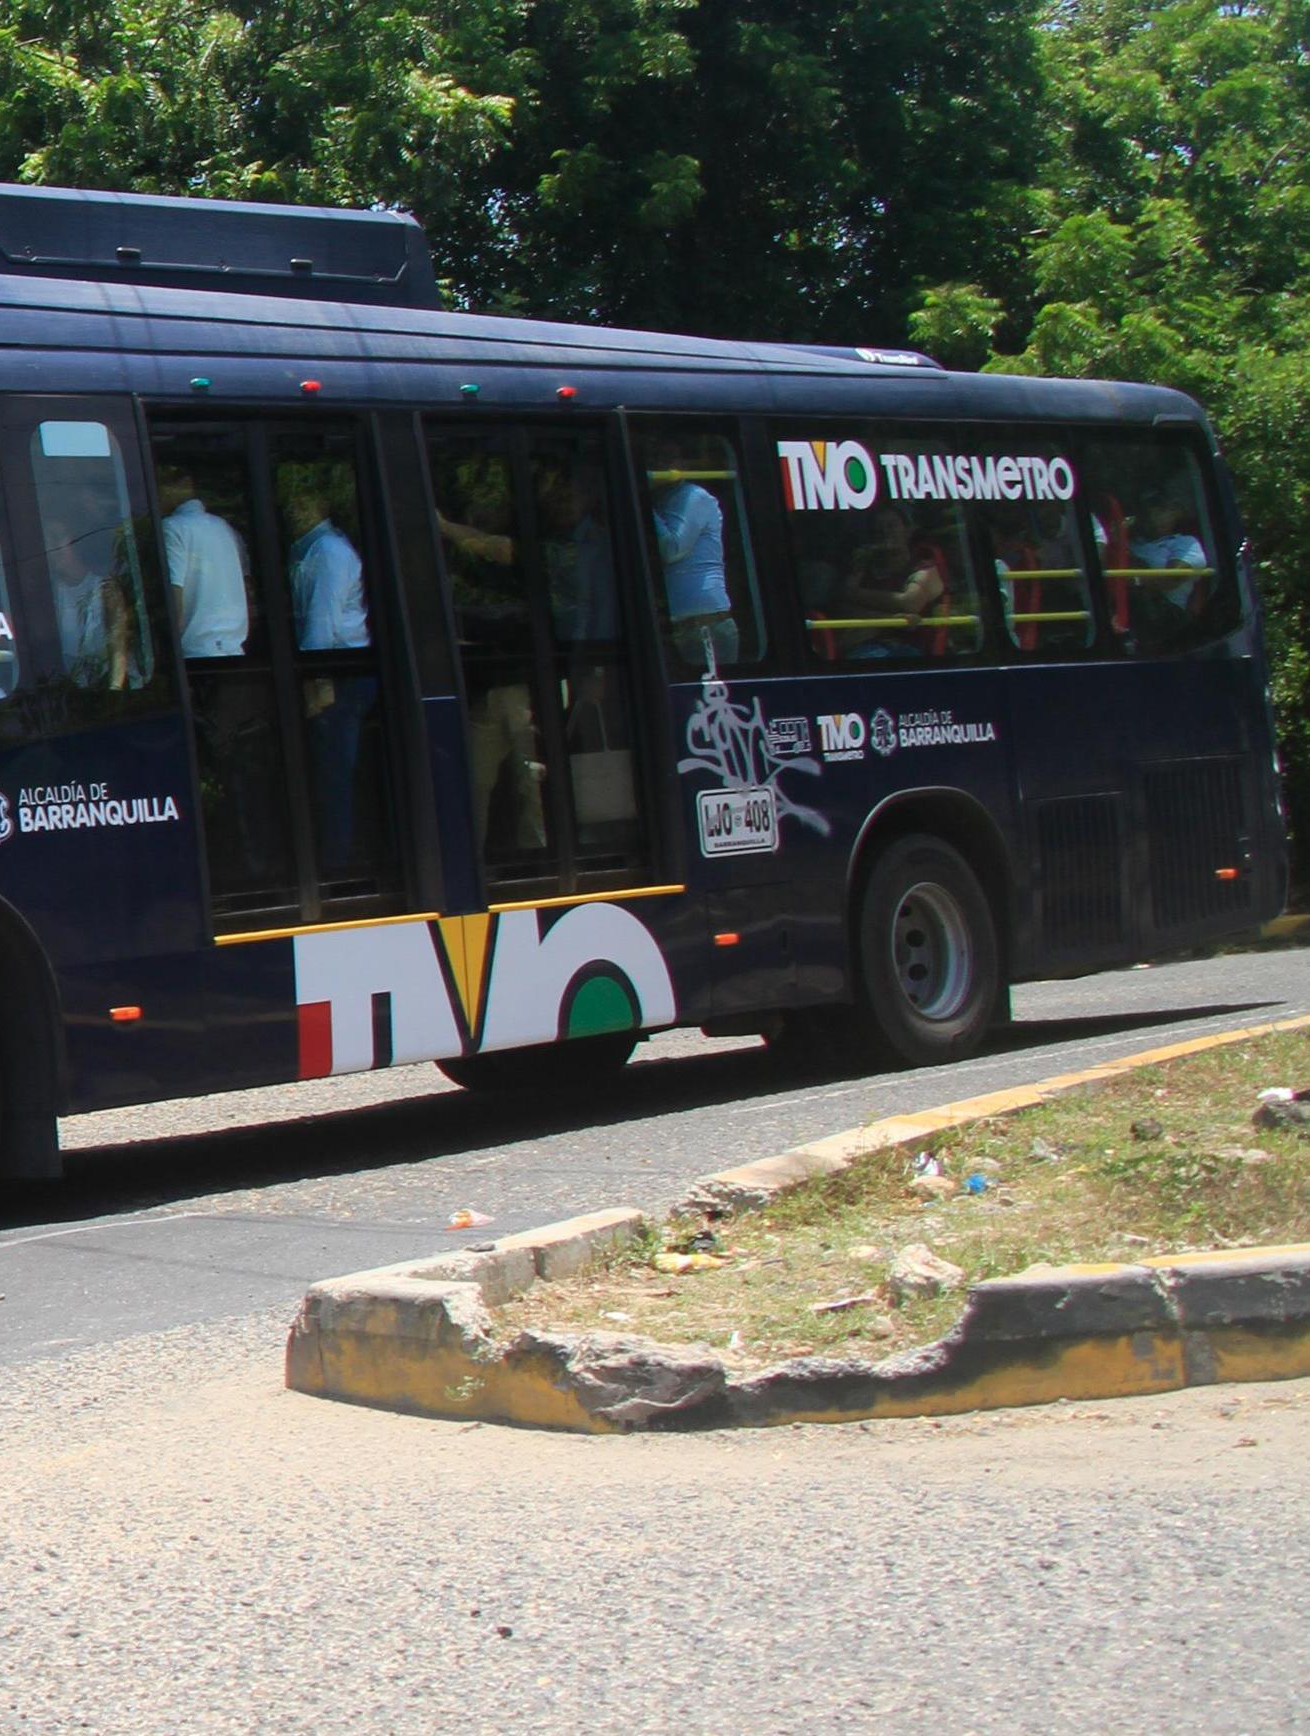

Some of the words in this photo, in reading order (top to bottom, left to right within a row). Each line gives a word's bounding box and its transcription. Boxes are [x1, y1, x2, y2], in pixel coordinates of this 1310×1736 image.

[778, 441, 877, 510] TMO
[817, 713, 865, 750] TMO
[941, 710, 953, 725] DE
[899, 723, 996, 748] BARRANQUILLA
[19, 781, 84, 805] ALCALDÍA
[88, 783, 109, 801] DE
[19, 797, 179, 833] BARRANQUILLA
